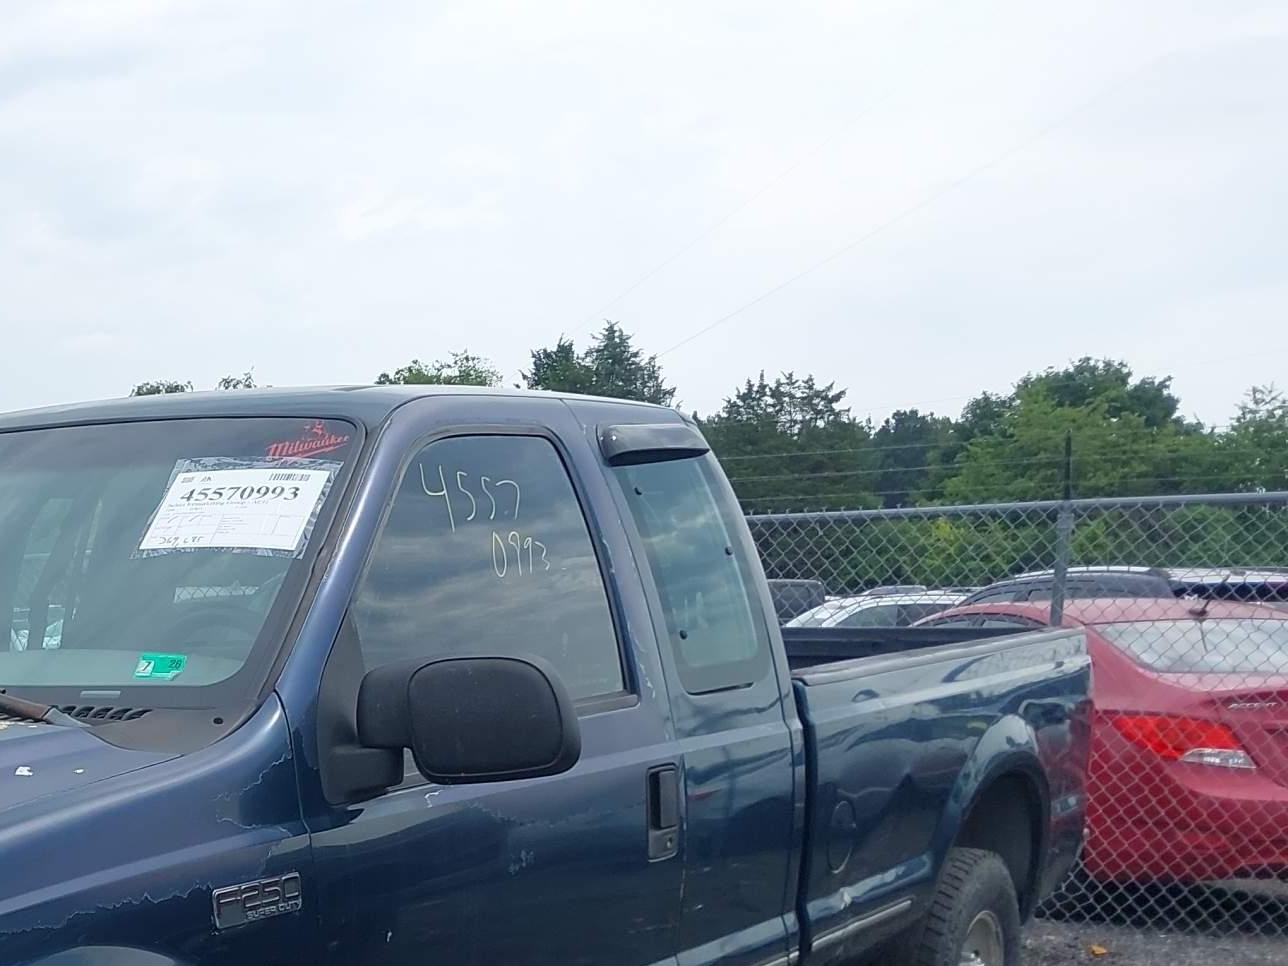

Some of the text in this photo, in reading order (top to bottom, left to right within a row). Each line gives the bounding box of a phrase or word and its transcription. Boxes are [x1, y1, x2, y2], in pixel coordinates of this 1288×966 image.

[265, 433, 350, 461] Milwaukee
[180, 485, 300, 502] 45570993
[419, 463, 520, 533] 4557
[492, 531, 551, 578] 0993
[142, 660, 153, 672] 7
[246, 905, 277, 920] SUPER
